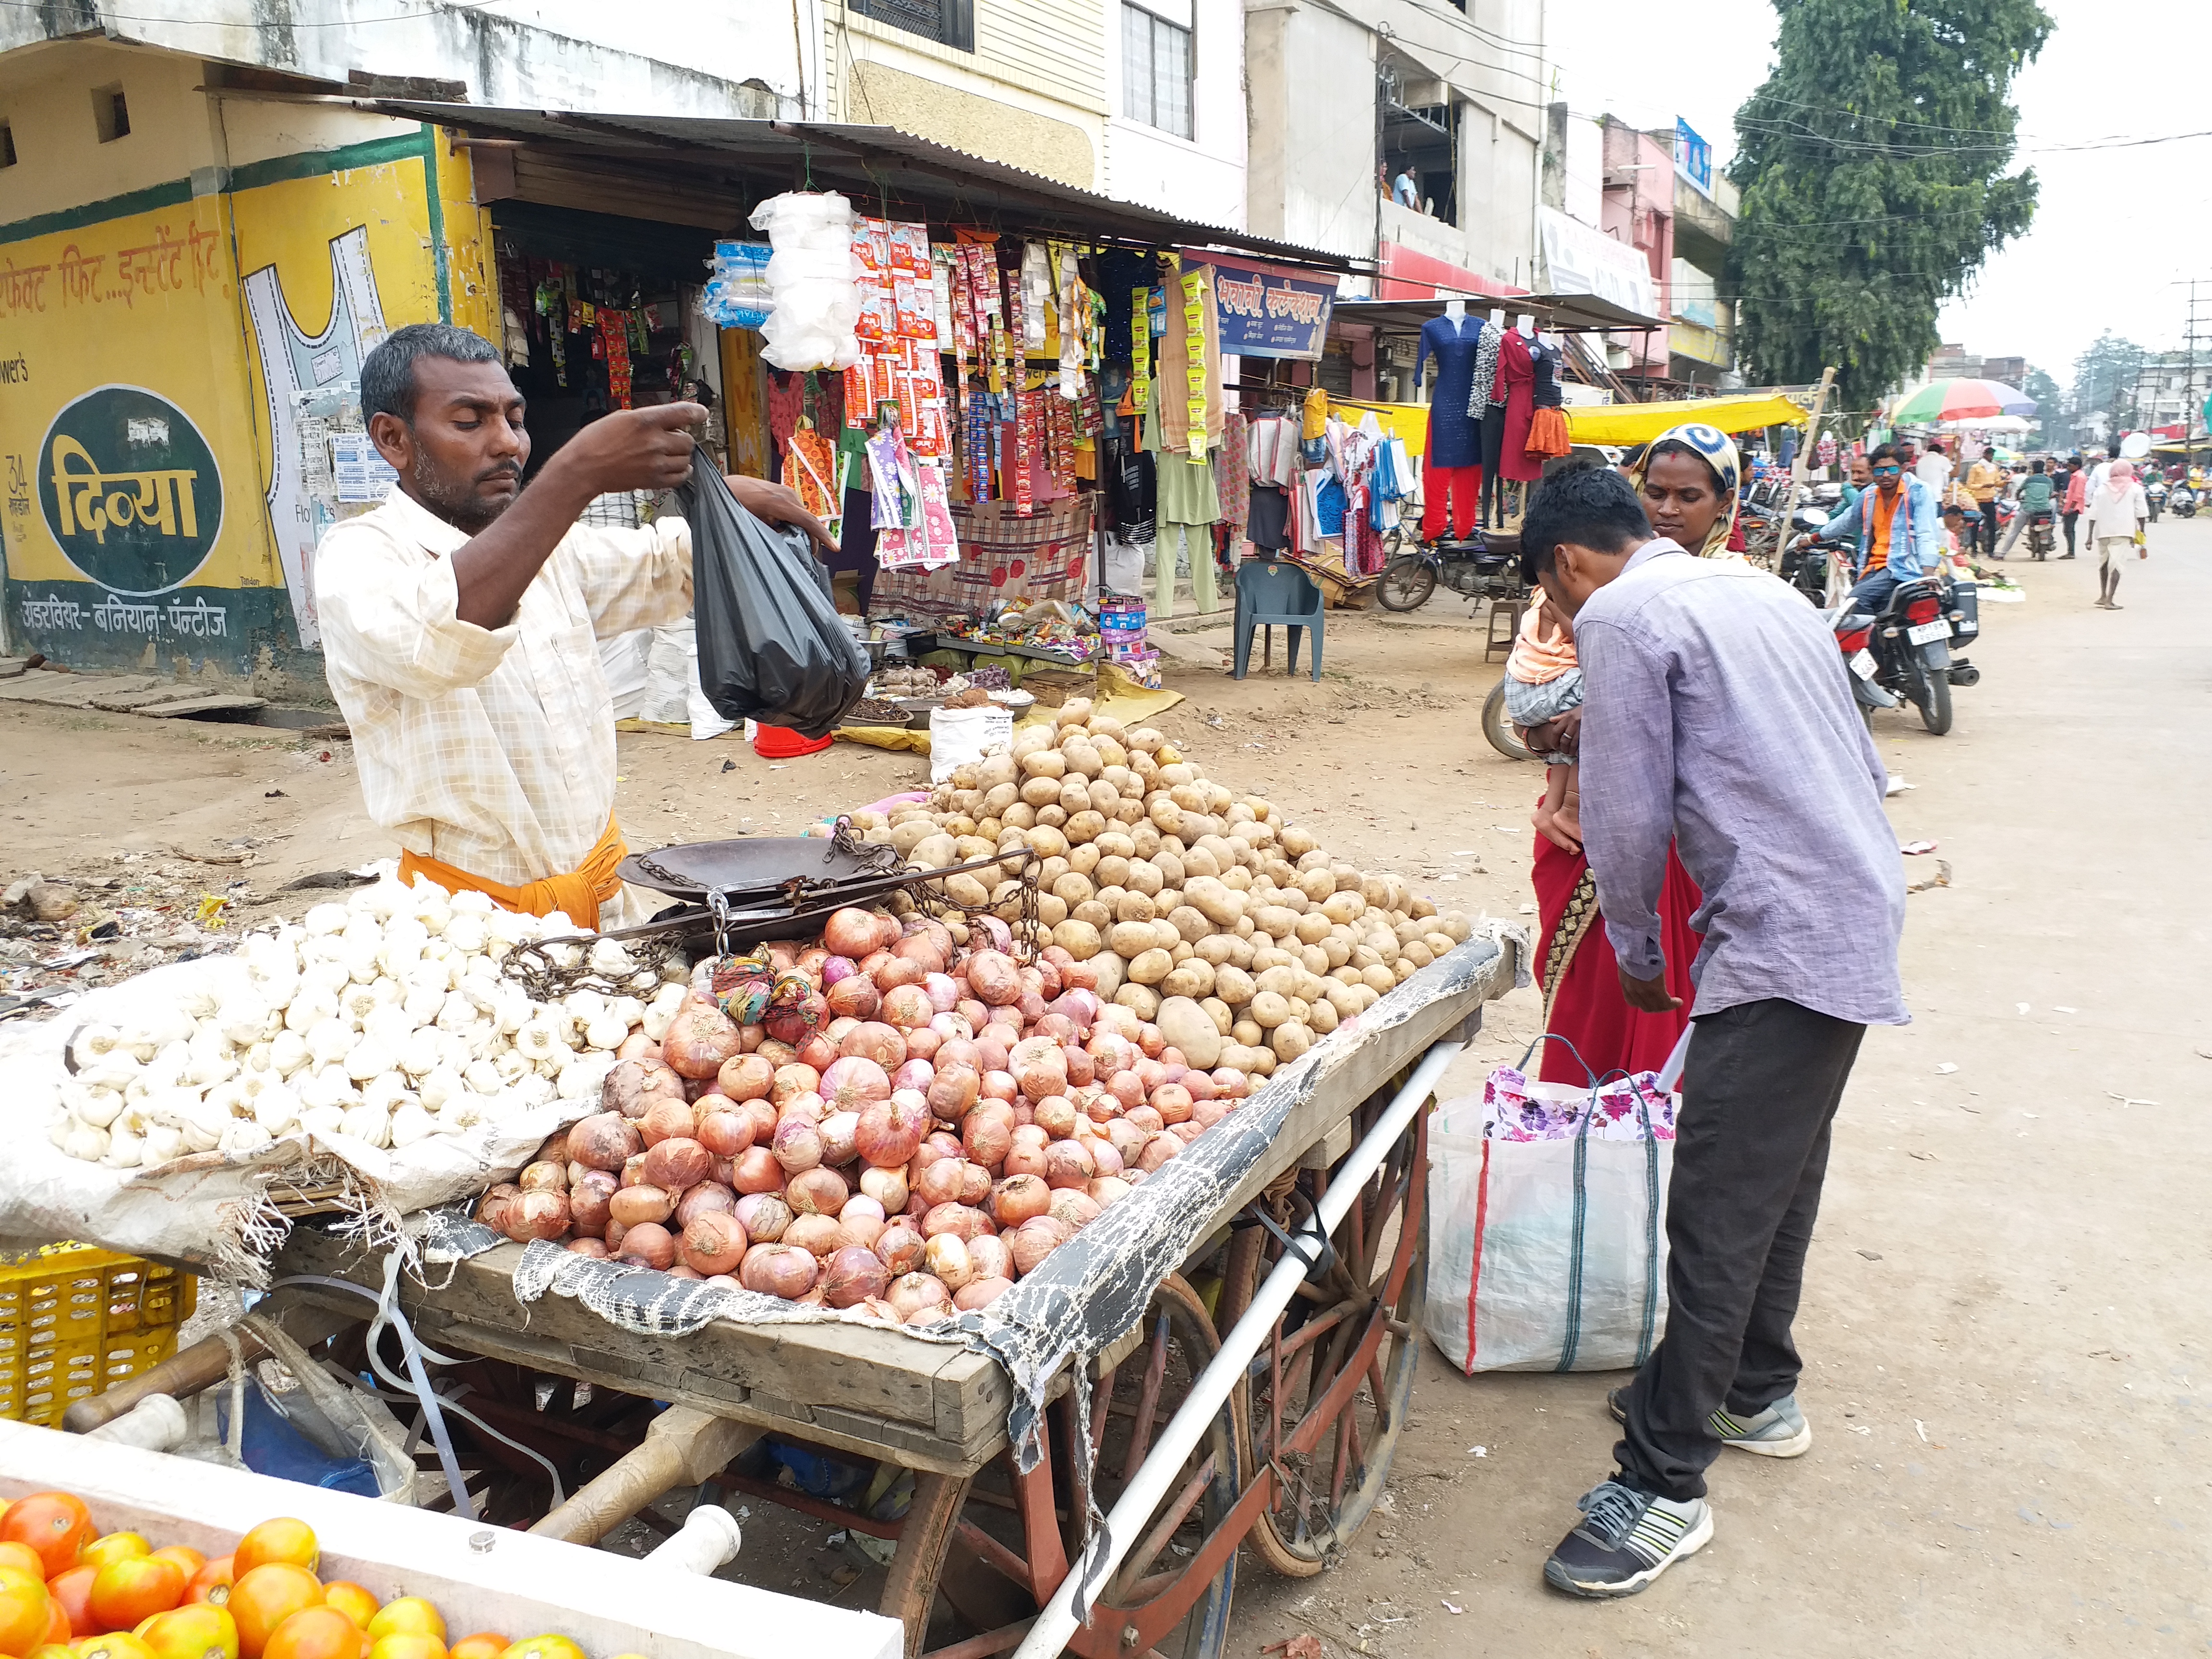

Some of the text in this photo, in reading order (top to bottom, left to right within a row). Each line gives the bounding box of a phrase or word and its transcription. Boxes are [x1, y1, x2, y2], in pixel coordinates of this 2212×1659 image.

[1217, 274, 1324, 325] भवानी कलेक्शन
[5, 454, 28, 494] 34
[51, 434, 198, 544] दिव्या
